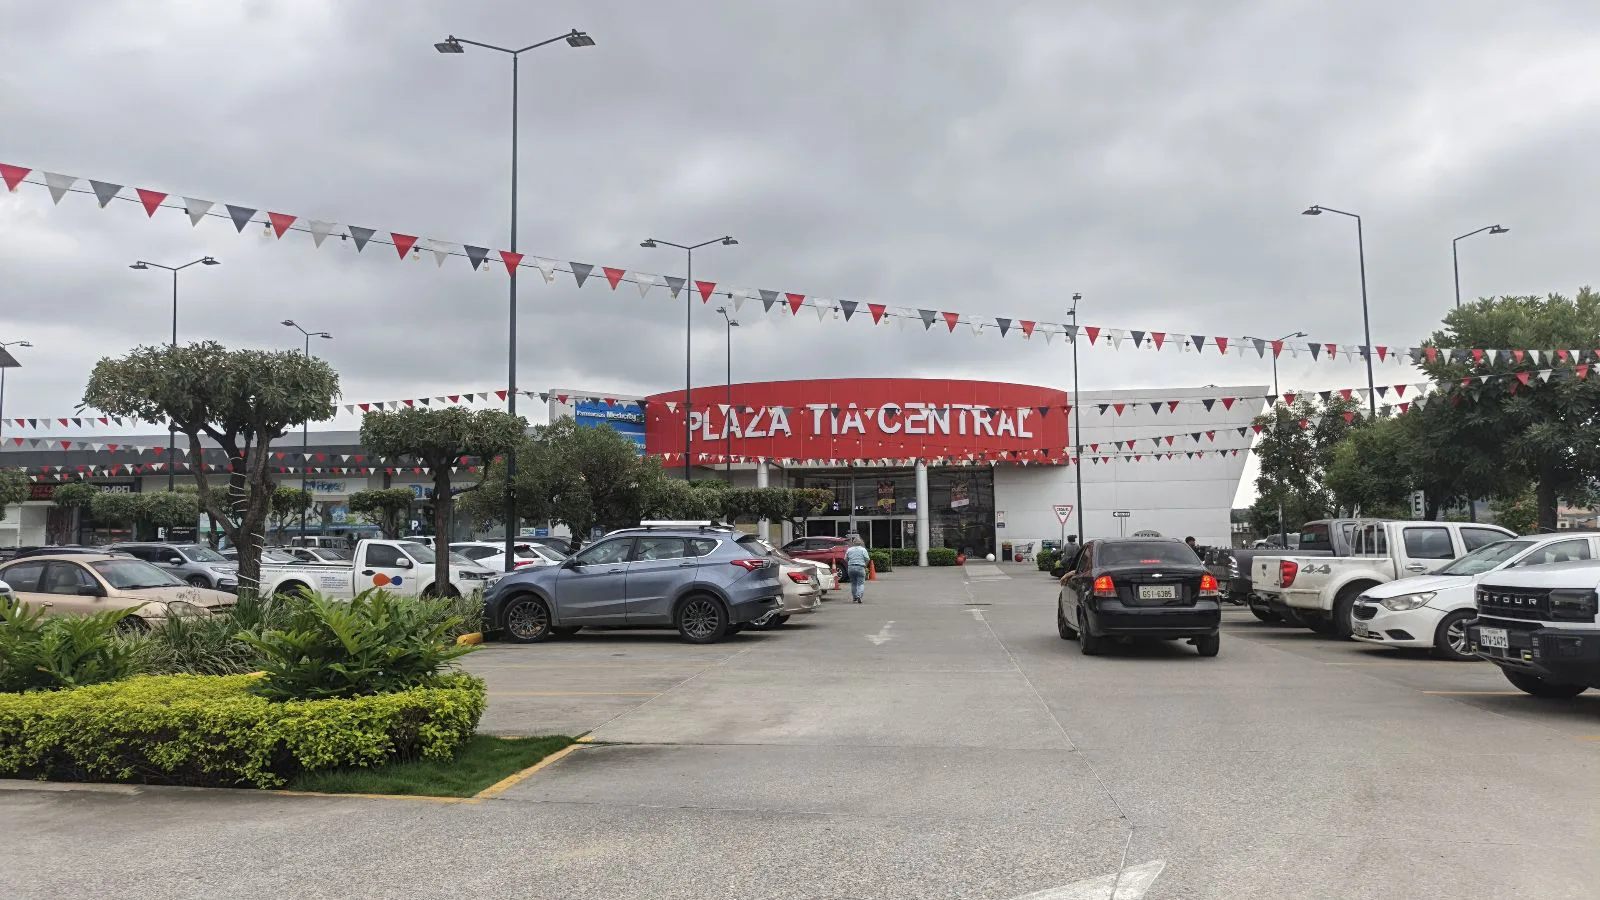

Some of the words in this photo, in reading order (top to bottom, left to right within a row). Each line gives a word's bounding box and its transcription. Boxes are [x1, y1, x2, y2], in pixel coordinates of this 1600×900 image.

[689, 406, 792, 441] PLAZA
[806, 403, 866, 435] TIA
[877, 403, 1033, 438] CENTRAL
